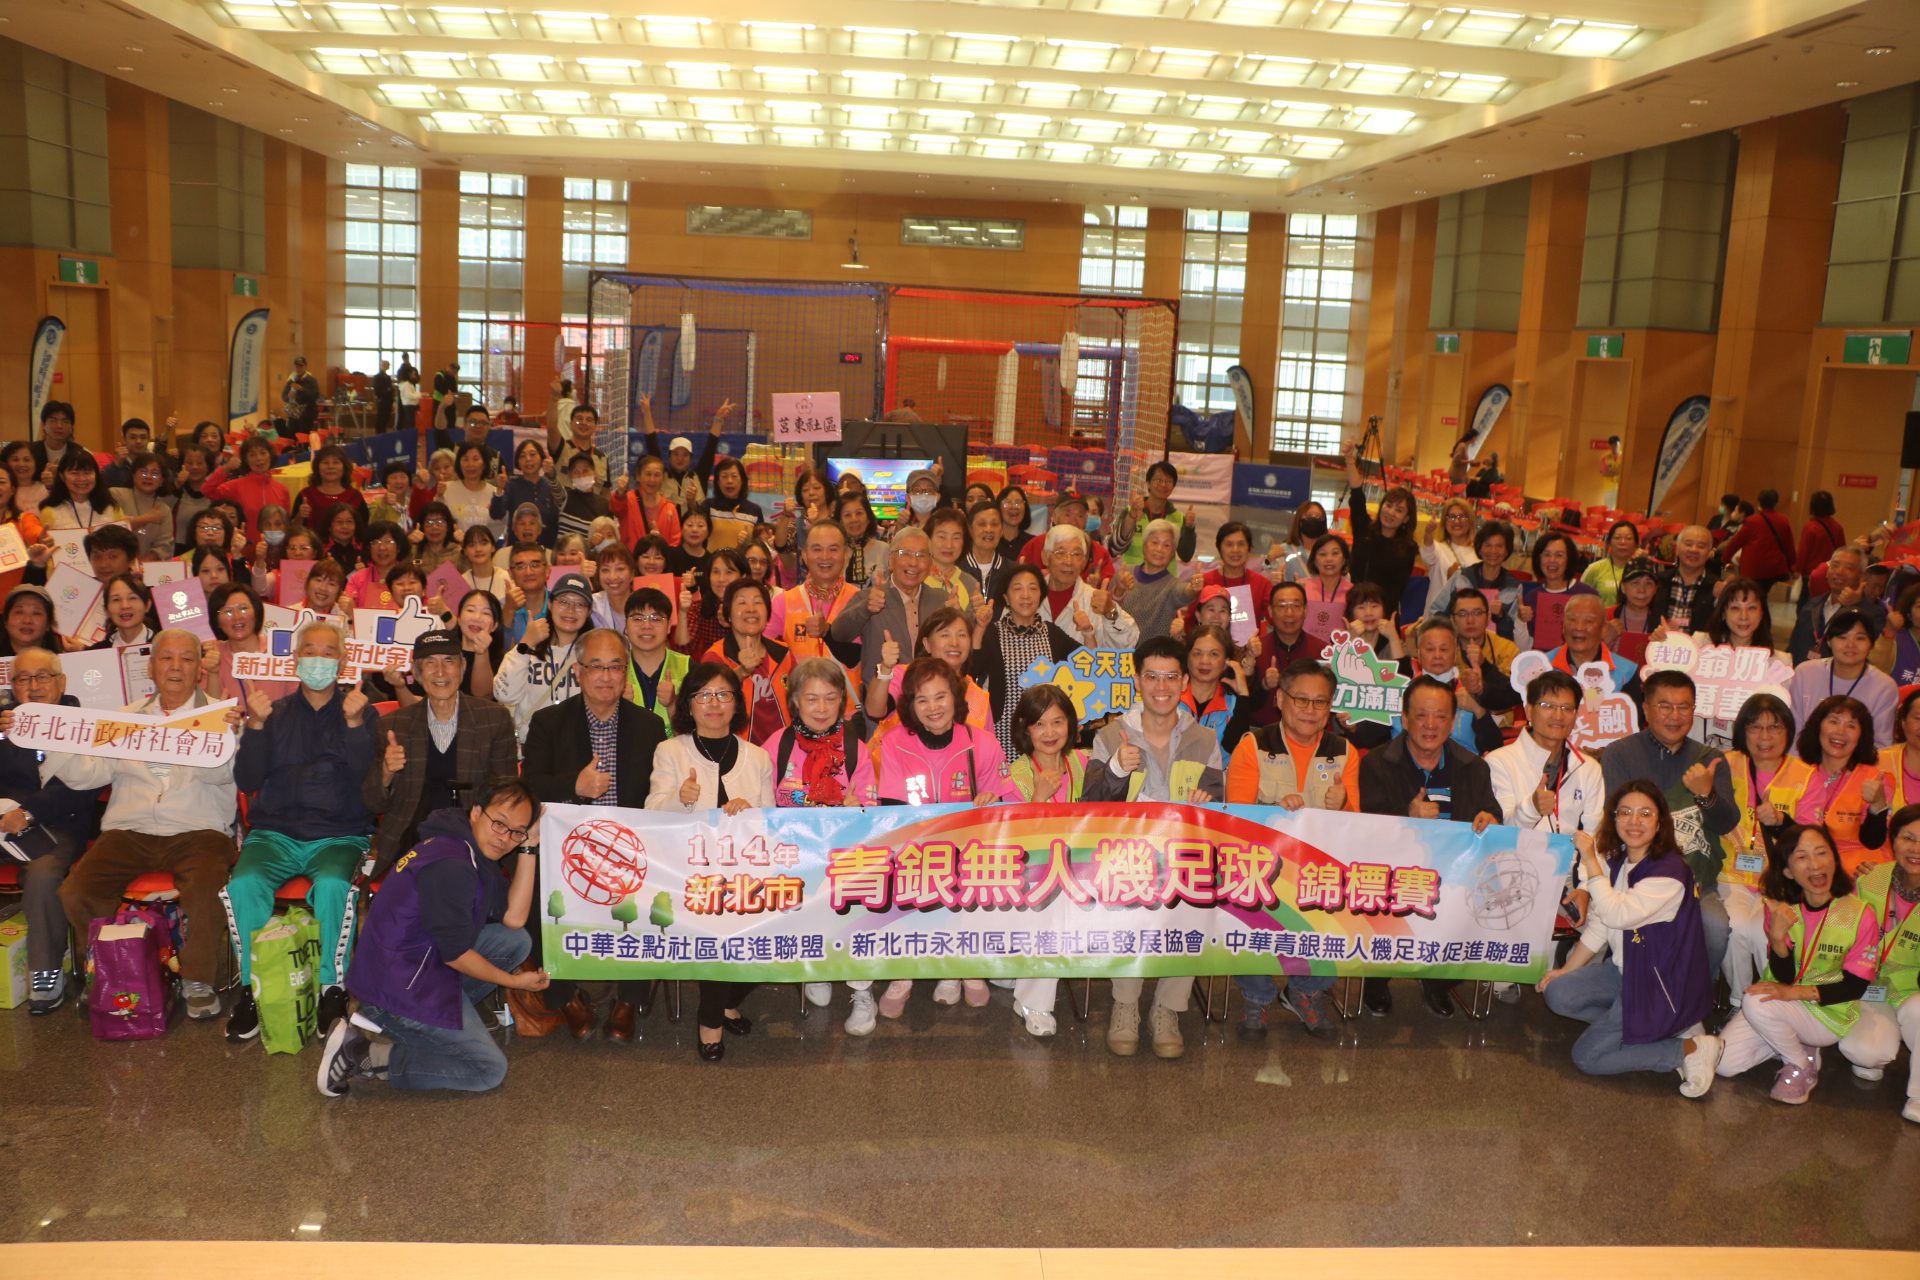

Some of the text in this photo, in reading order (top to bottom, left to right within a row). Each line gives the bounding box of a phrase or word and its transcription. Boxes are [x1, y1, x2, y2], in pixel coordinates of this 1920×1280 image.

[344, 643, 414, 668] 新北金
[1653, 645, 1769, 682] 我的 爺奶
[15, 711, 225, 759] 新北市政府社會局
[688, 835, 799, 868] 114年
[685, 875, 803, 914] 新北市
[828, 840, 1439, 915] 青銀無人機足球 錦標賽
[1818, 944, 1844, 953] JUDGE
